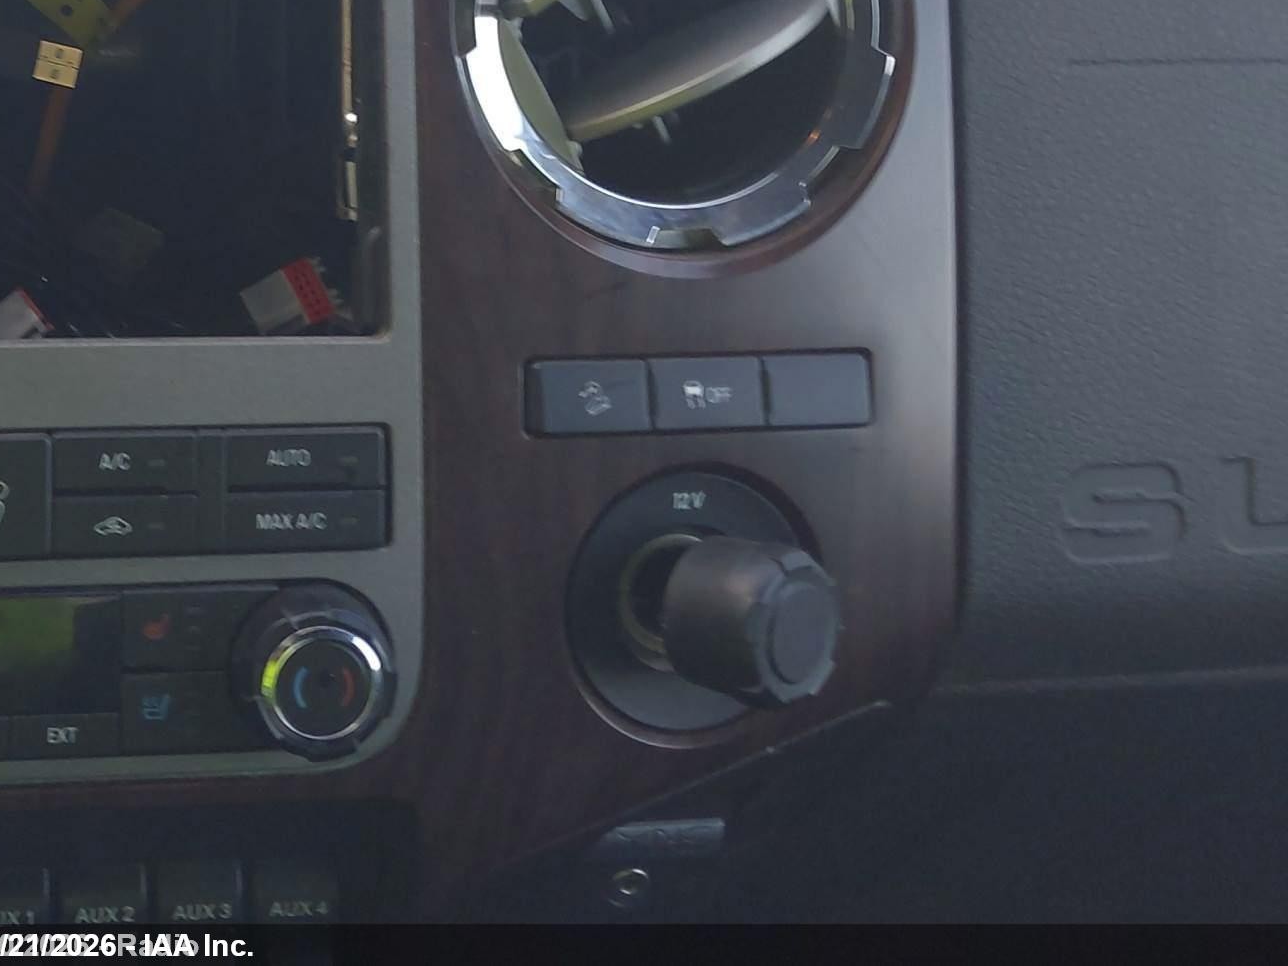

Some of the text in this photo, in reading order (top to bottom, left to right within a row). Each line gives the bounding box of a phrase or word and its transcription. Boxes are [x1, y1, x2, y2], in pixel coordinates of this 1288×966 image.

[706, 386, 732, 404] OFF
[98, 452, 131, 471] A/C
[266, 448, 312, 467] AUTO
[672, 490, 707, 510] 12V
[256, 511, 328, 531] MAX A/C
[46, 726, 79, 744] EXT
[26, 910, 35, 926] 1
[73, 905, 136, 924] AUX 2
[171, 902, 233, 922] AUX 3
[268, 900, 329, 918] AUX 4
